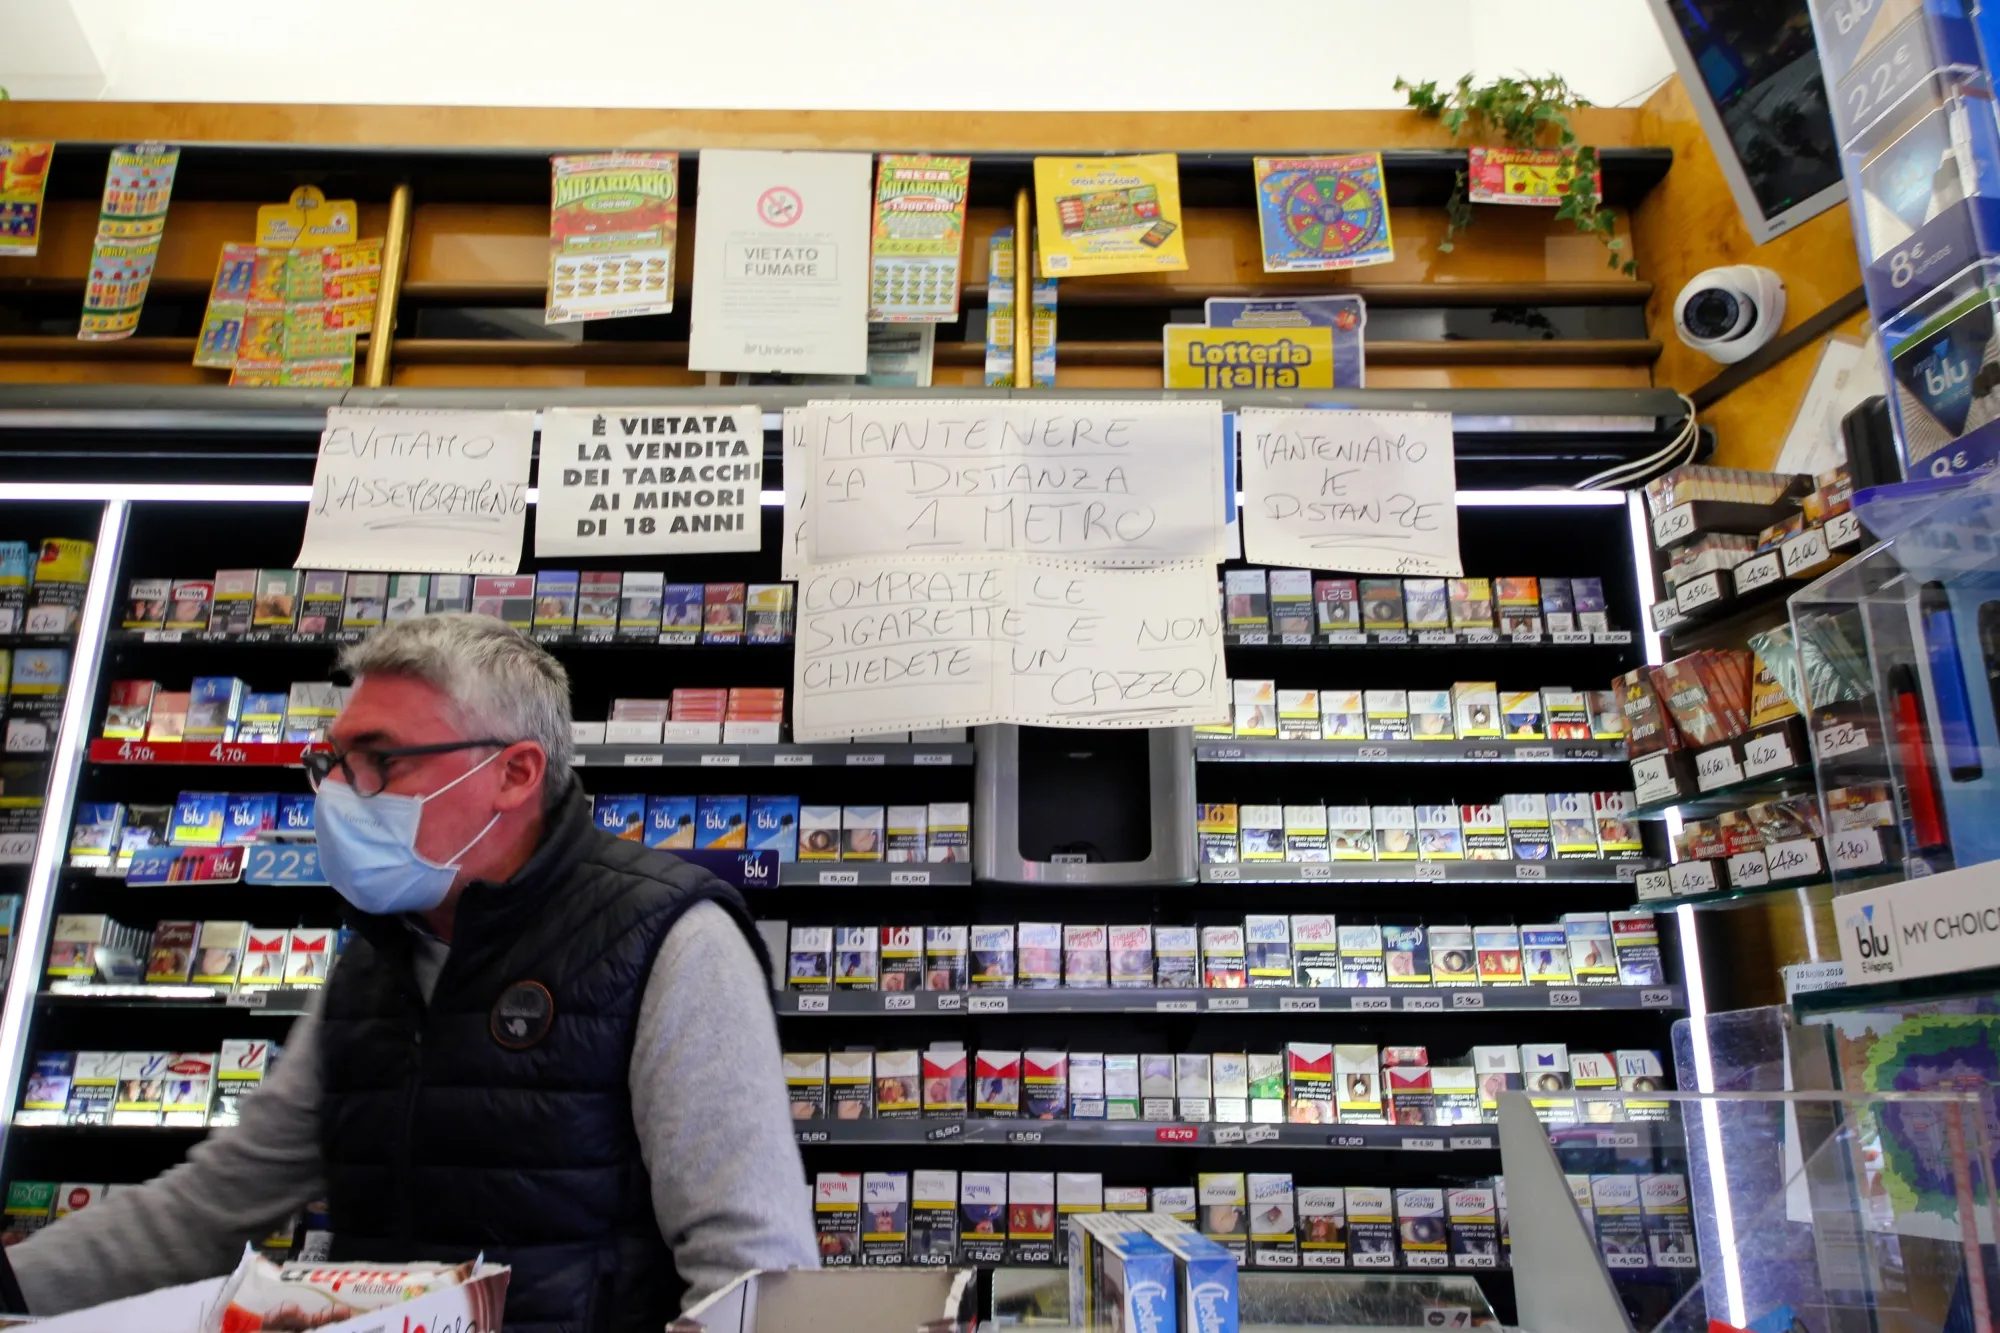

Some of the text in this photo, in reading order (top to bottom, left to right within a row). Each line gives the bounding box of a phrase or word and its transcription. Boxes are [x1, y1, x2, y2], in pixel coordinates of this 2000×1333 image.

[555, 173, 675, 209] MILIARDARIO
[744, 247, 819, 262] VIETATO
[744, 263, 818, 277] FUMARE
[1188, 337, 1312, 367] Lotteria
[1205, 363, 1299, 389] Italia
[1925, 358, 1969, 396] blu
[591, 413, 738, 437] È VIETATA
[822, 411, 1137, 457] MANTENERE
[577, 439, 751, 464] LA VENDITA
[562, 462, 762, 487] DEI TABACCHI
[825, 458, 1131, 500] LA DISTANZA
[588, 489, 745, 512] AI MINORI
[575, 514, 745, 538] DI 18 ANNI
[983, 497, 1157, 547] METRO
[804, 568, 1088, 611] COMPRATE LE
[1320, 589, 1353, 600] 821
[806, 606, 1222, 648] SIGARETTE E NON
[802, 646, 1070, 690] CHIEDETE UN
[1050, 654, 1219, 706] CAZZO!
[1823, 728, 1857, 750] 5,20
[183, 808, 205, 825] blu
[233, 809, 255, 827] blu
[287, 811, 309, 827] blu
[603, 812, 624, 828] blu
[655, 814, 676, 829] blu
[705, 814, 727, 830] blu
[757, 814, 778, 830] blu
[213, 857, 236, 874] blu
[743, 859, 769, 878] blu
[1855, 907, 2000, 960] blu MY CHOIC
[1016, 1132, 1042, 1141] 5,90
[1168, 1130, 1193, 1139] 2,70
[818, 1180, 848, 1196] Winston
[866, 1180, 895, 1197] Winston
[965, 1184, 991, 1197] Winston
[1206, 1189, 1236, 1198] BENSON
[1303, 1200, 1335, 1208] BENSON
[1351, 1200, 1383, 1208] BENSON
[1403, 1200, 1435, 1208] BENSON
[1455, 1200, 1486, 1208] BENSON
[826, 1255, 852, 1265] 5,00
[875, 1254, 901, 1265] 5,00
[920, 1255, 946, 1265] 5,00
[975, 1252, 1001, 1262] 5,00
[1023, 1252, 1049, 1261] 5,00
[1268, 1255, 1294, 1264] 4,90
[1315, 1256, 1341, 1265] 4,90
[1365, 1254, 1391, 1264] 4,90
[1419, 1256, 1446, 1266] 4,90
[1466, 1256, 1493, 1266] 4,90
[1618, 1256, 1645, 1265] 4,90
[1667, 1255, 1693, 1265] 4,90
[351, 1284, 403, 1295] NOCCIOLATO
